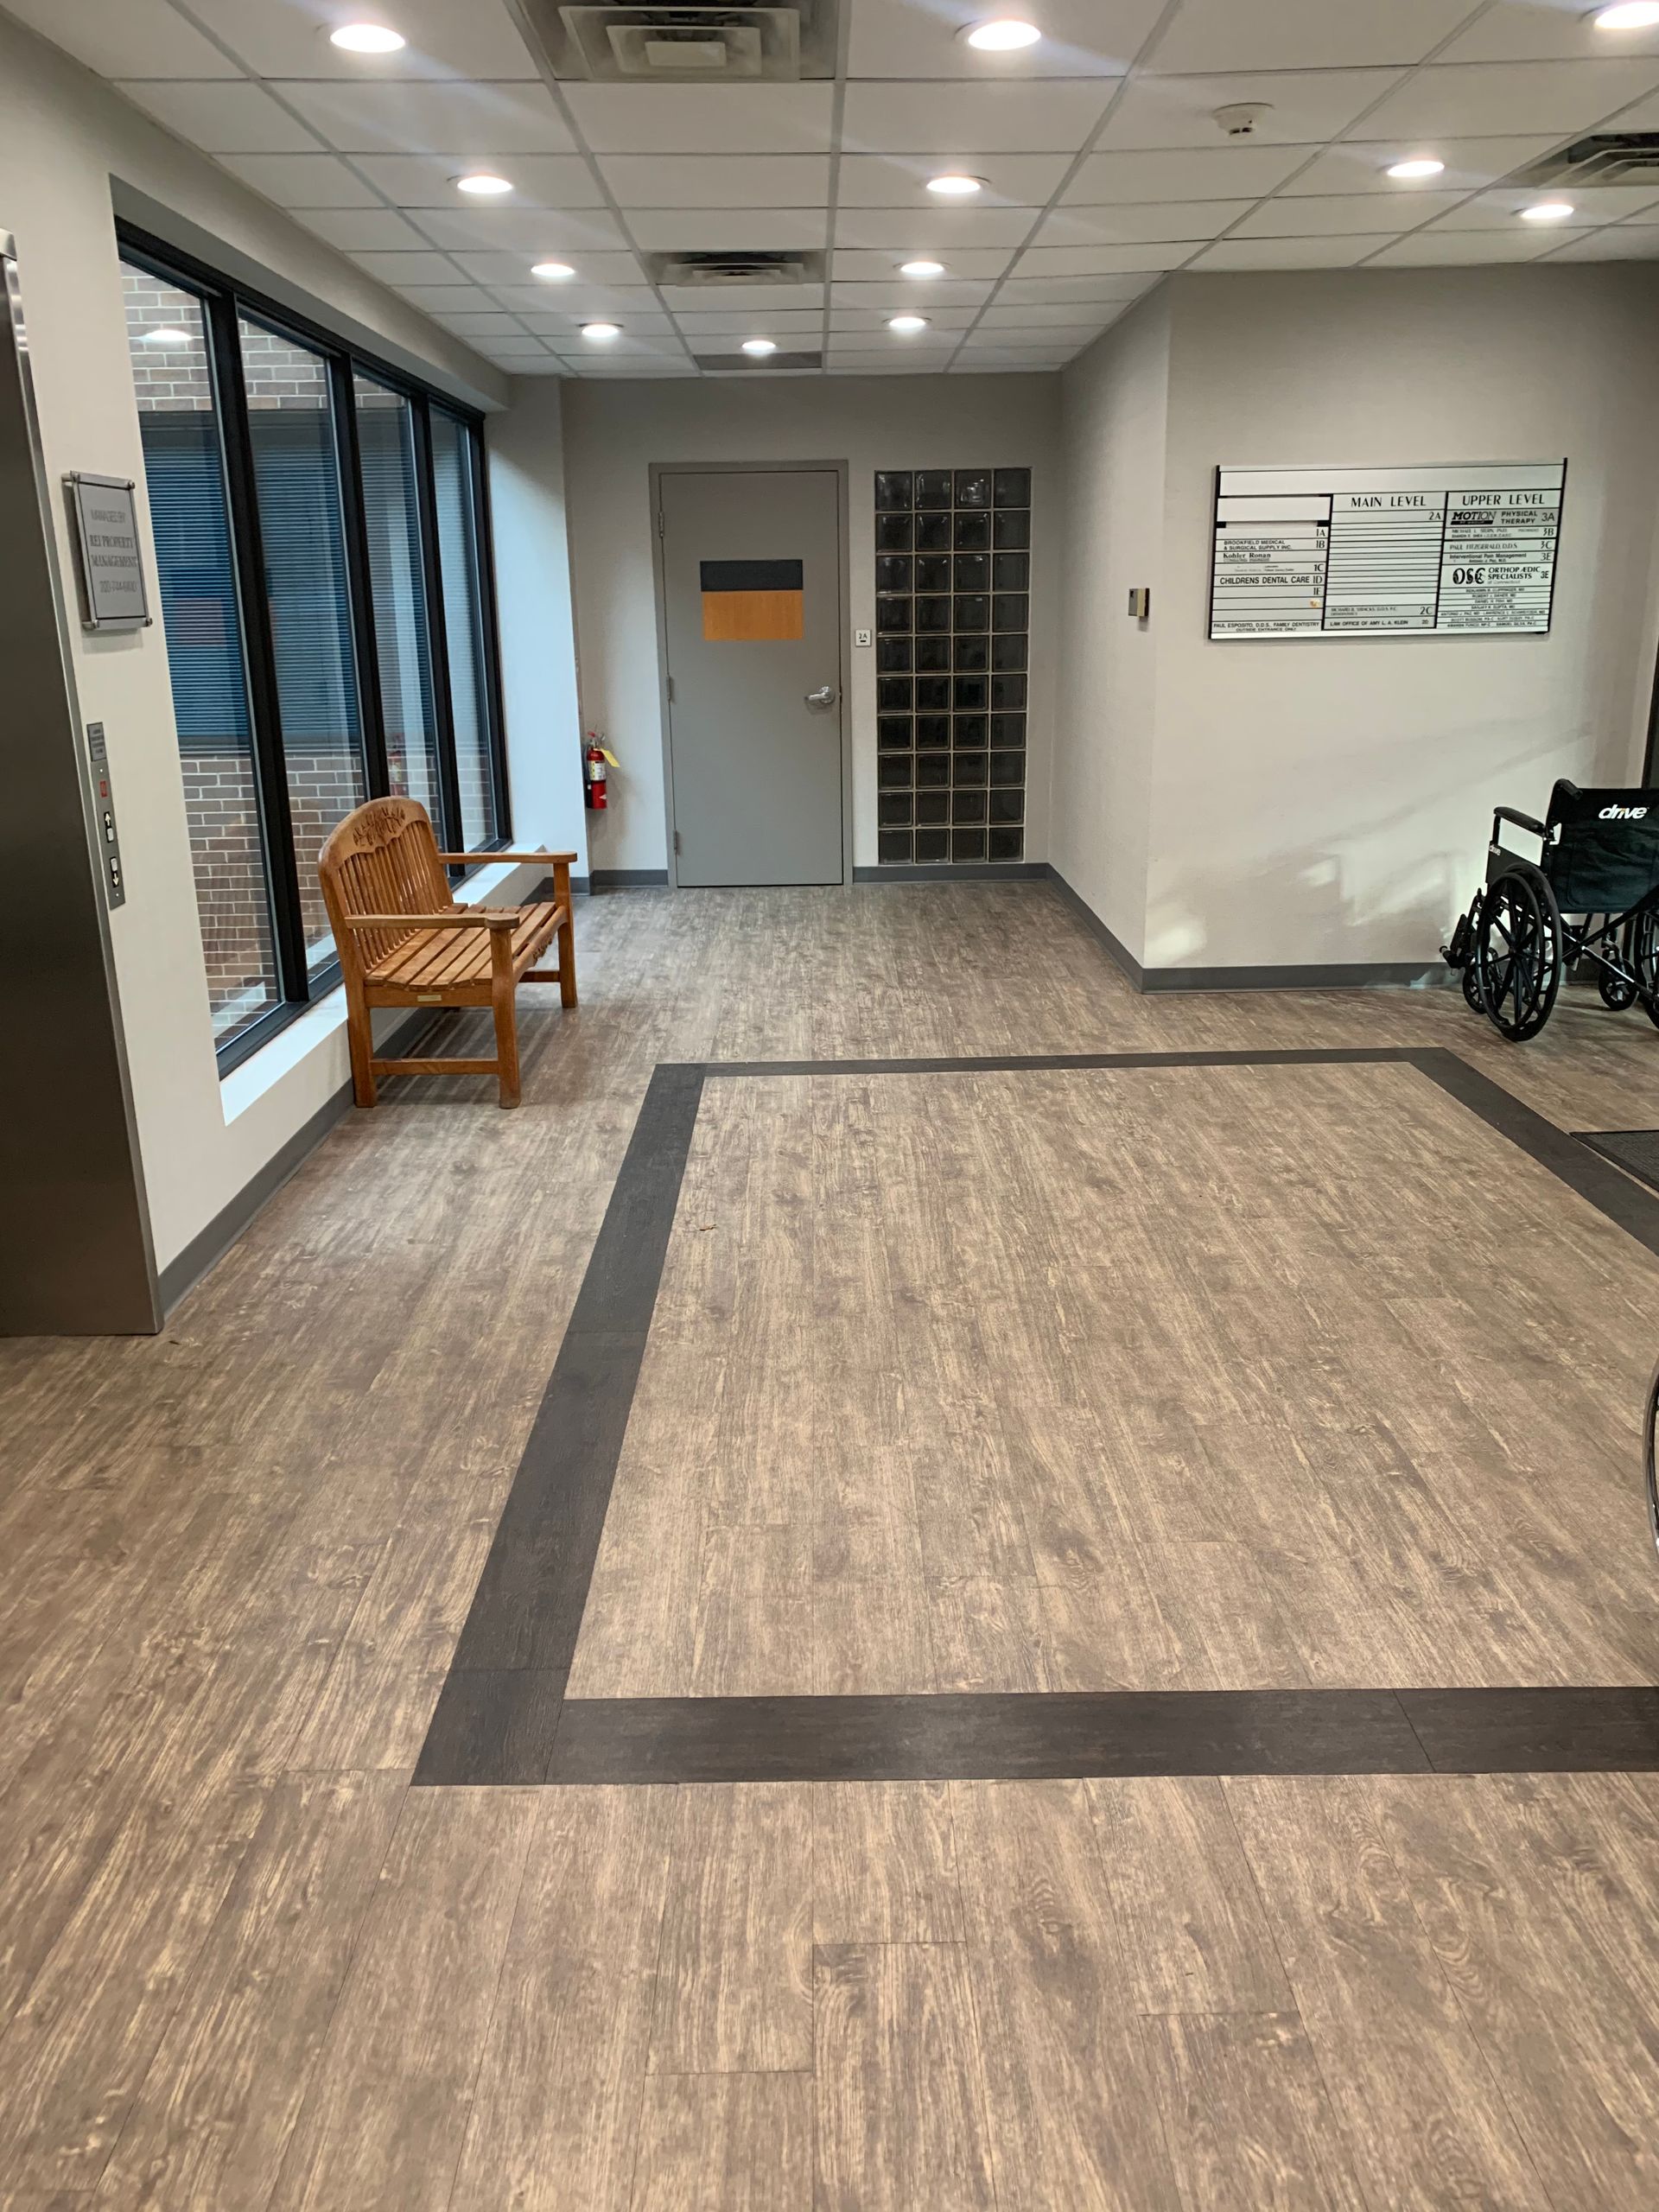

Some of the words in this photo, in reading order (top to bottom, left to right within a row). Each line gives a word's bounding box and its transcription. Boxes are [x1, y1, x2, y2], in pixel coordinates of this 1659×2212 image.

[1351, 497, 1382, 507] MAIN
[1390, 495, 1427, 506] LEVEL
[1462, 494, 1502, 505] UPPER
[1509, 493, 1545, 505] LEVEL
[1428, 512, 1441, 520] 2A
[1452, 511, 1497, 519] MOTION
[1541, 512, 1555, 522] 3A
[1543, 528, 1554, 537] 3B
[1541, 541, 1553, 550] 3C
[91, 555, 137, 567] MANAGEMENT
[1540, 570, 1549, 579] 3E
[1420, 606, 1433, 614] 2C
[1599, 804, 1647, 819] drive
